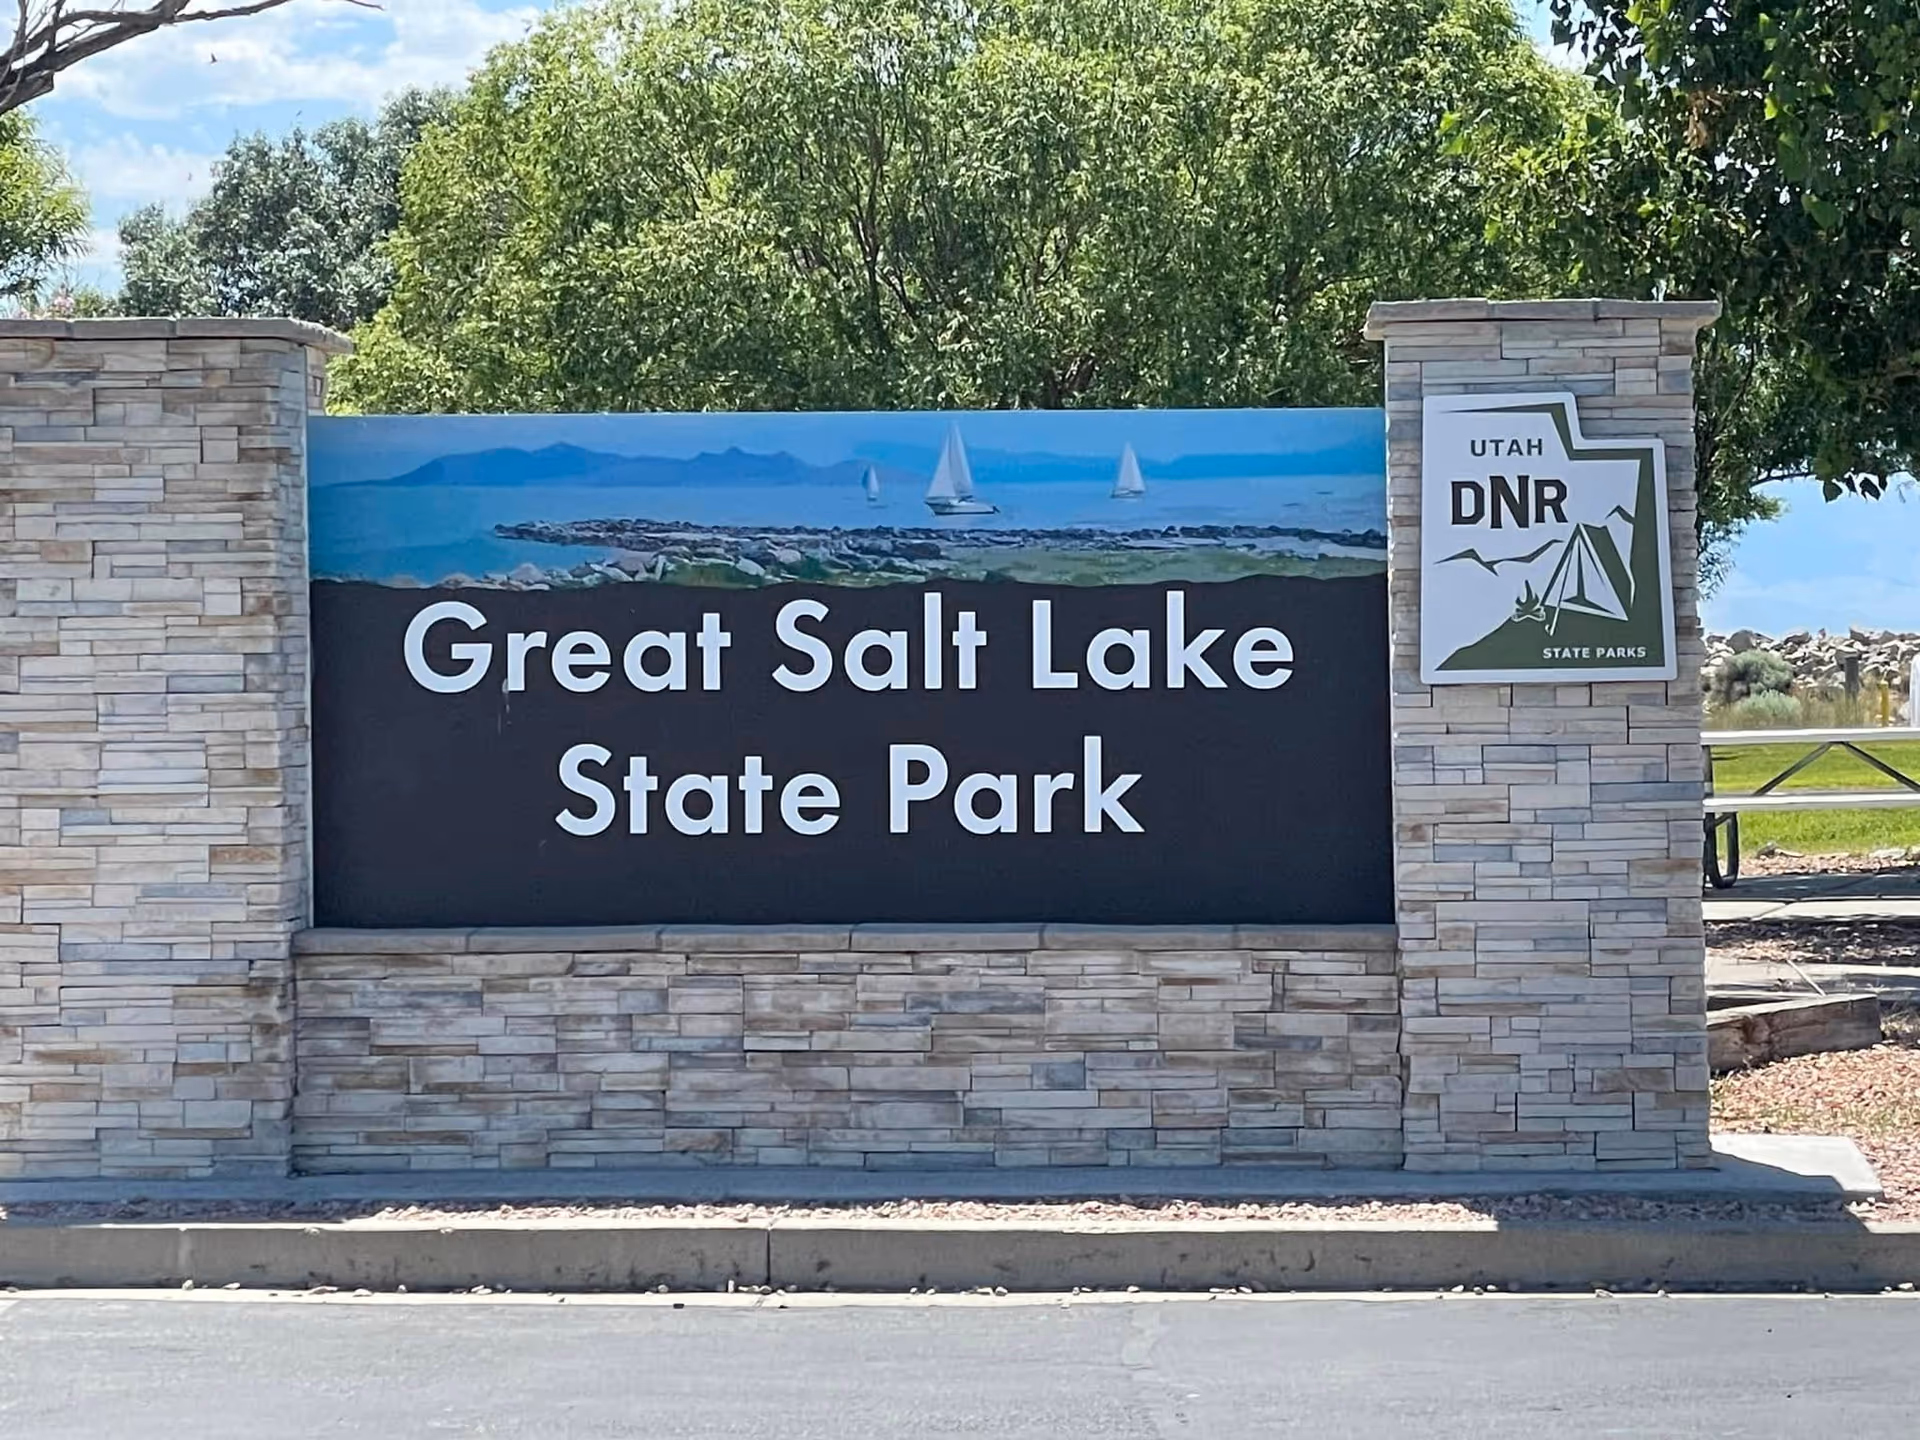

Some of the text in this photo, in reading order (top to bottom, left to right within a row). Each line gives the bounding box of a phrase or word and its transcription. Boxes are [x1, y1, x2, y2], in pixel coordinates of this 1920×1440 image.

[1470, 438, 1543, 457] UTAH
[1450, 475, 1568, 529] DNR
[403, 590, 1294, 693] Great Salt Lake
[1542, 646, 1647, 659] STATE PARKS
[555, 735, 1145, 836] State Park
